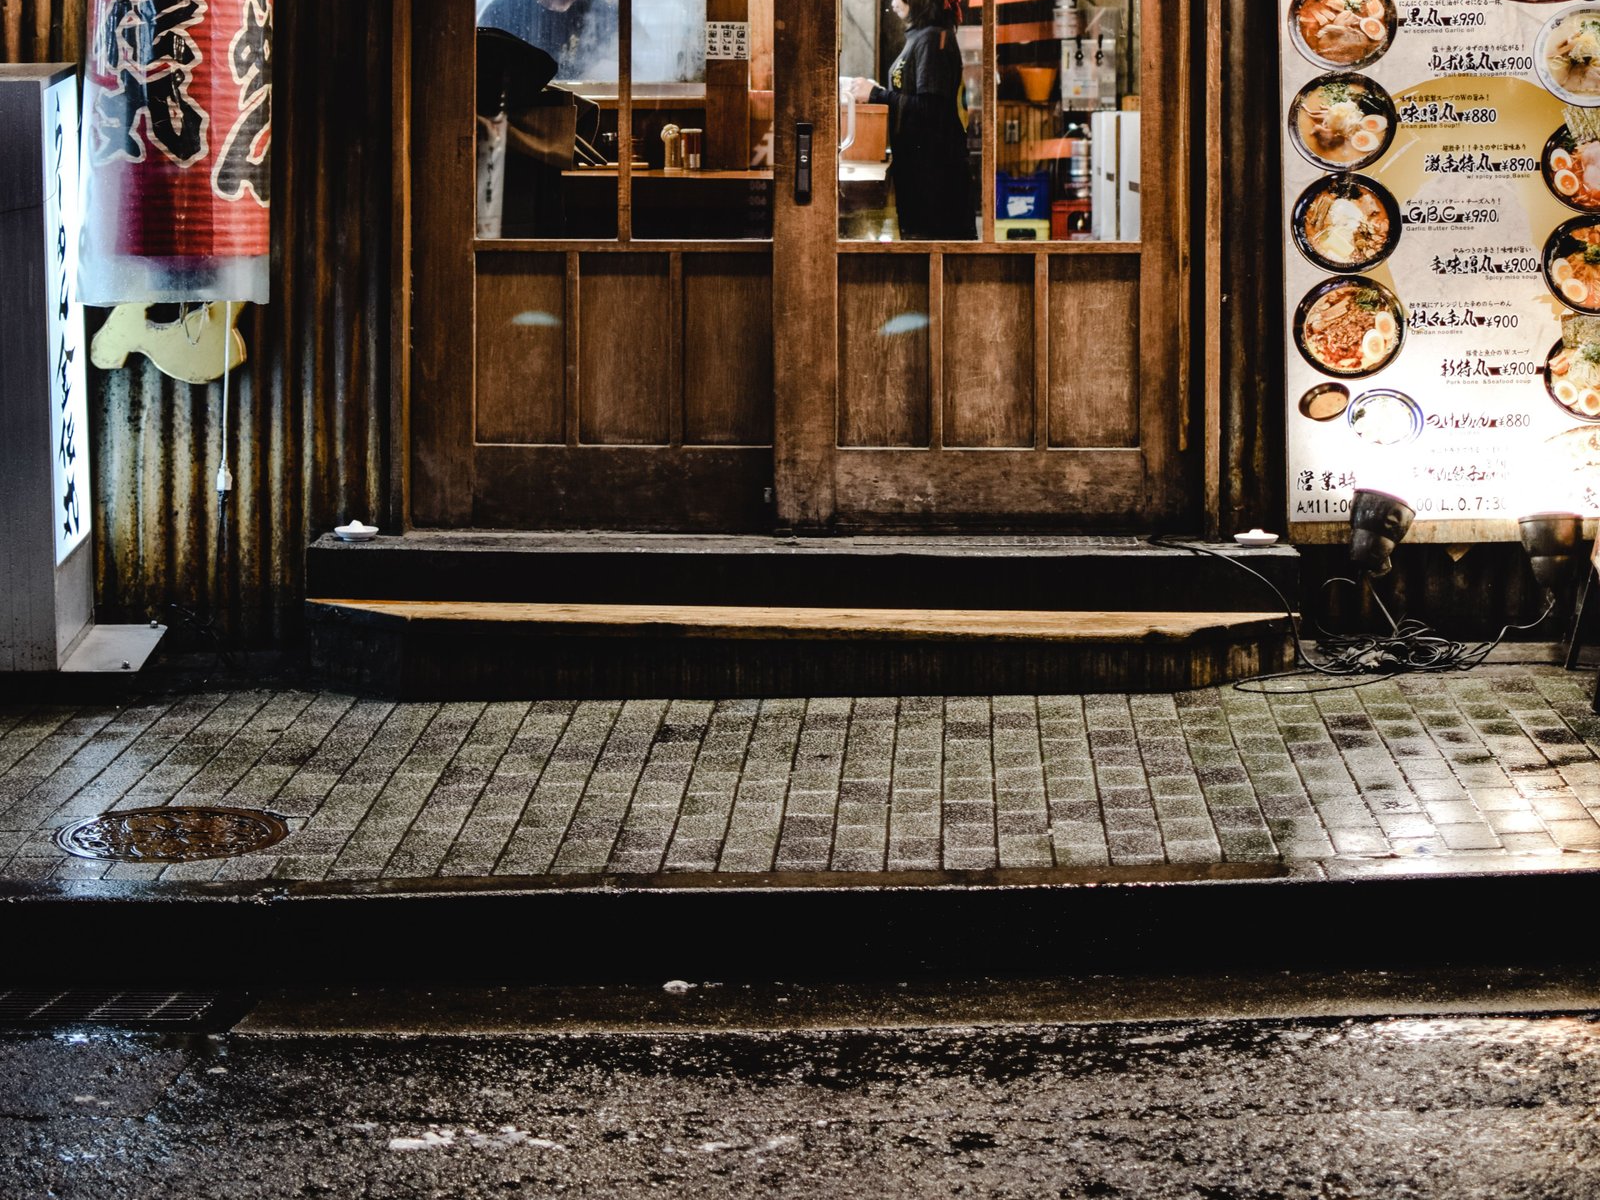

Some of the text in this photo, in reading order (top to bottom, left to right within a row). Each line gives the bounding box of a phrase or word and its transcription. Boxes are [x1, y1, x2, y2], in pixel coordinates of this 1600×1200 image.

[1401, 103, 1497, 122] 味噌丸 ¥880
[1501, 158, 1535, 172] ¥890
[1503, 257, 1537, 272] ¥900
[1485, 315, 1519, 328] ¥900
[1502, 361, 1535, 375] ¥900
[1498, 413, 1530, 428] ¥880
